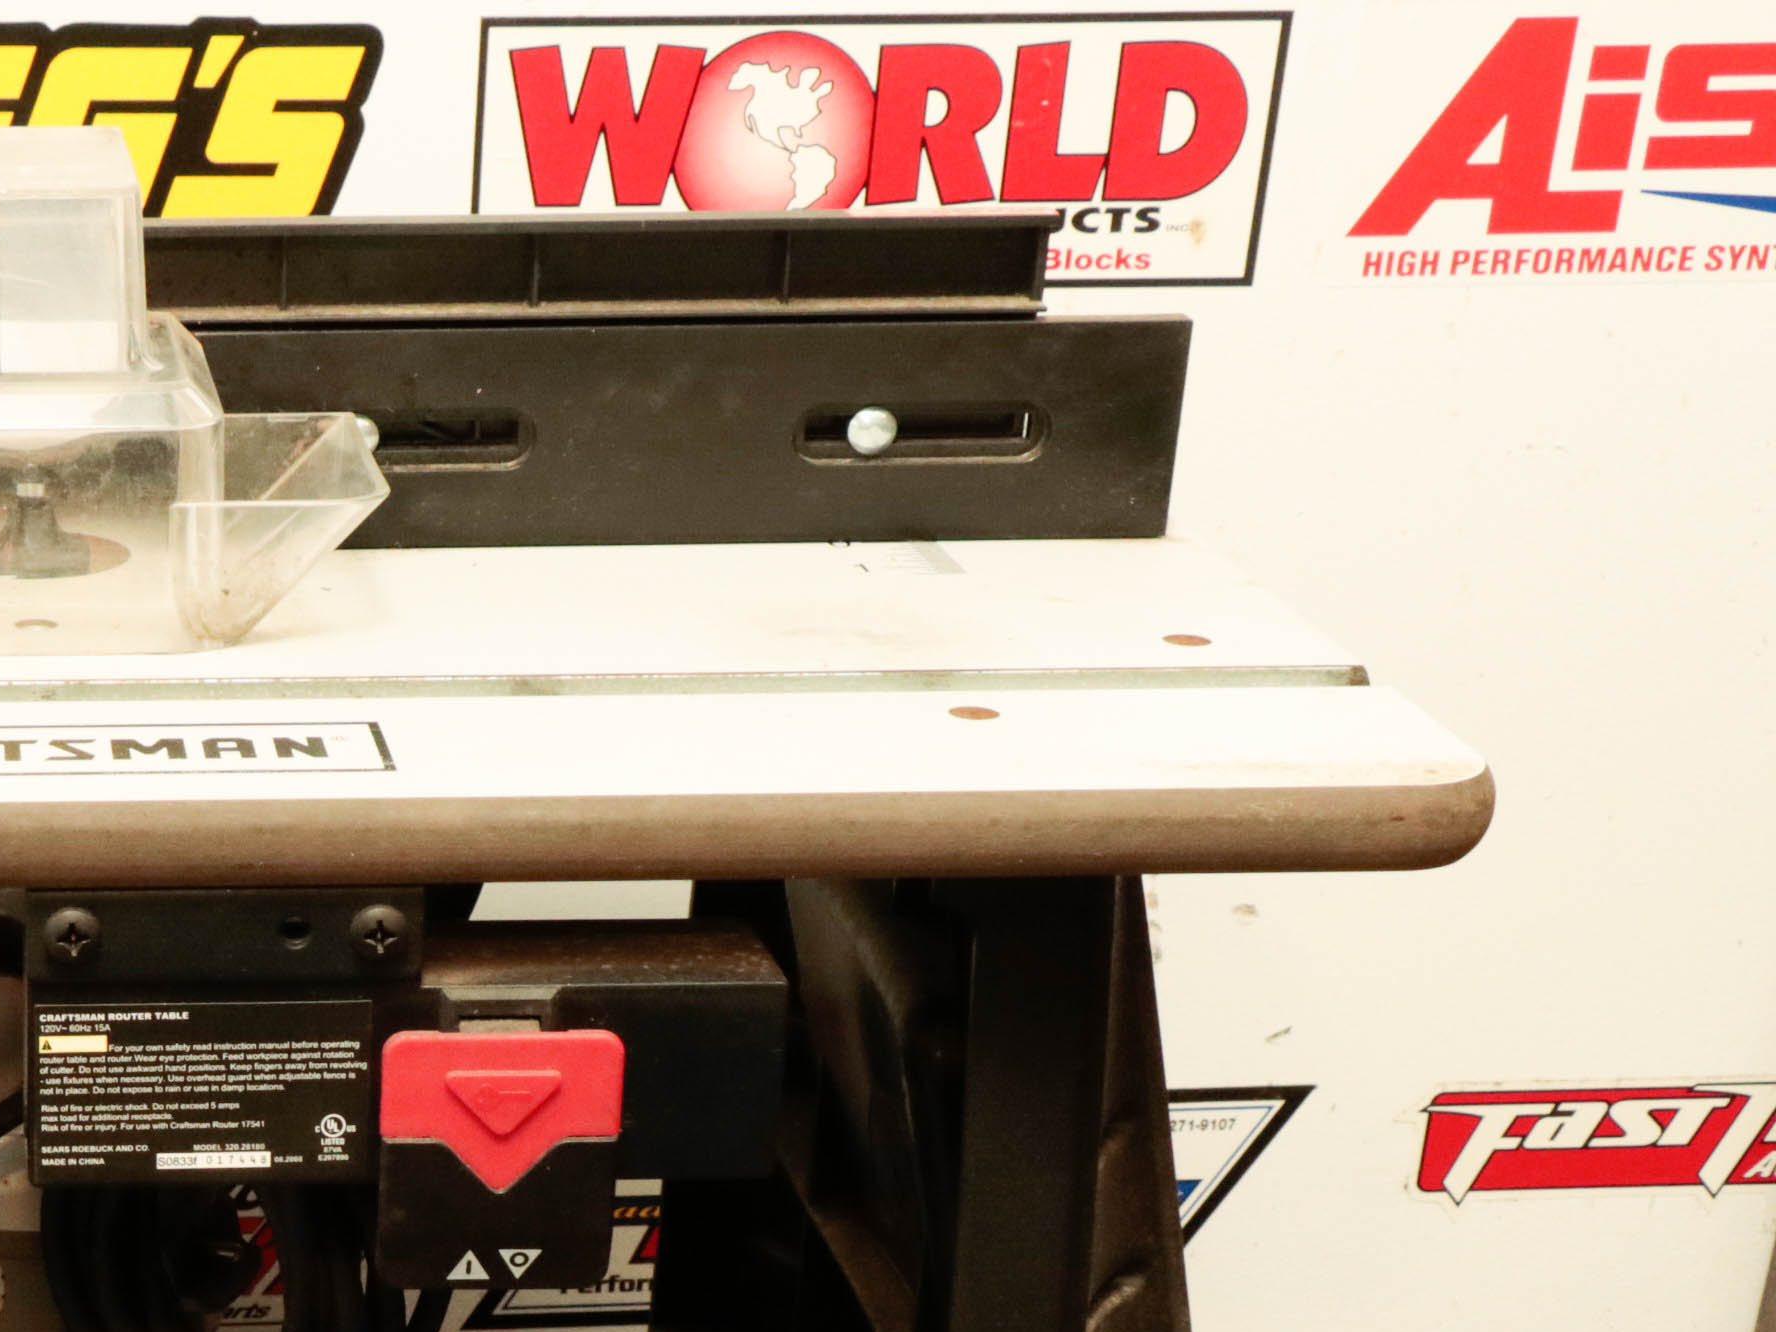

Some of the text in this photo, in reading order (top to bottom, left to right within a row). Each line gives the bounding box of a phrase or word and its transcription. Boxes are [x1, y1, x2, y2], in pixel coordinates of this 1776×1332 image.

[510, 31, 1248, 209] WORLD
[1046, 248, 1152, 270] Blocks
[1362, 250, 1441, 278] HIGH
[1449, 245, 1696, 276] PERFORMANCE
[39, 1012, 189, 1022] CRAFTSMAN ROUTER TABLE
[95, 1024, 111, 1032] 15A
[109, 1044, 122, 1052] For
[125, 1045, 144, 1053] your
[165, 1043, 191, 1052] safety
[192, 1042, 212, 1050] read
[213, 1042, 256, 1050] instruction
[259, 1041, 290, 1049] manual
[321, 1041, 360, 1050] operating
[90, 1055, 105, 1063] and
[159, 1055, 174, 1063] eye
[246, 1052, 288, 1060] workpiece
[290, 1052, 321, 1060] against
[323, 1051, 354, 1059] rotation
[40, 1066, 49, 1074] of
[79, 1065, 91, 1073] Do
[93, 1065, 106, 1073] not
[126, 1064, 163, 1072] awkward
[165, 1064, 186, 1072] hand
[230, 1063, 252, 1072] Keep
[254, 1062, 282, 1071] fingers
[285, 1063, 307, 1071] away
[330, 1061, 367, 1070] revolving
[63, 1076, 94, 1084] fixtures
[186, 1074, 225, 1082] overhead
[228, 1074, 252, 1082] guard
[279, 1072, 321, 1081] adjustable
[323, 1071, 346, 1079] fence
[349, 1071, 356, 1079] is
[40, 1087, 54, 1095] not
[55, 1087, 63, 1095] in
[92, 1086, 105, 1094] Do
[107, 1086, 120, 1094] not
[122, 1086, 153, 1095] expose
[155, 1085, 164, 1093] to
[165, 1085, 181, 1093] rain
[211, 1084, 219, 1092] in
[221, 1084, 245, 1093] damp
[41, 1104, 58, 1113] Risk
[60, 1104, 68, 1112] of
[70, 1104, 83, 1112] fire
[180, 1102, 209, 1110] exceed
[218, 1102, 240, 1110] amps
[41, 1114, 58, 1122] max
[60, 1114, 77, 1122] load
[91, 1113, 129, 1121] additional
[41, 1124, 58, 1132] Risk
[60, 1123, 68, 1131] of
[70, 1123, 83, 1131] fire
[120, 1123, 134, 1131] For
[152, 1122, 168, 1130] with
[170, 1121, 210, 1130] Craftsman
[241, 1120, 265, 1128] 17541
[41, 1145, 70, 1153] SEARS
[115, 1144, 133, 1152] AND
[42, 1158, 66, 1166] MADE
[78, 1157, 106, 1165] CHINA
